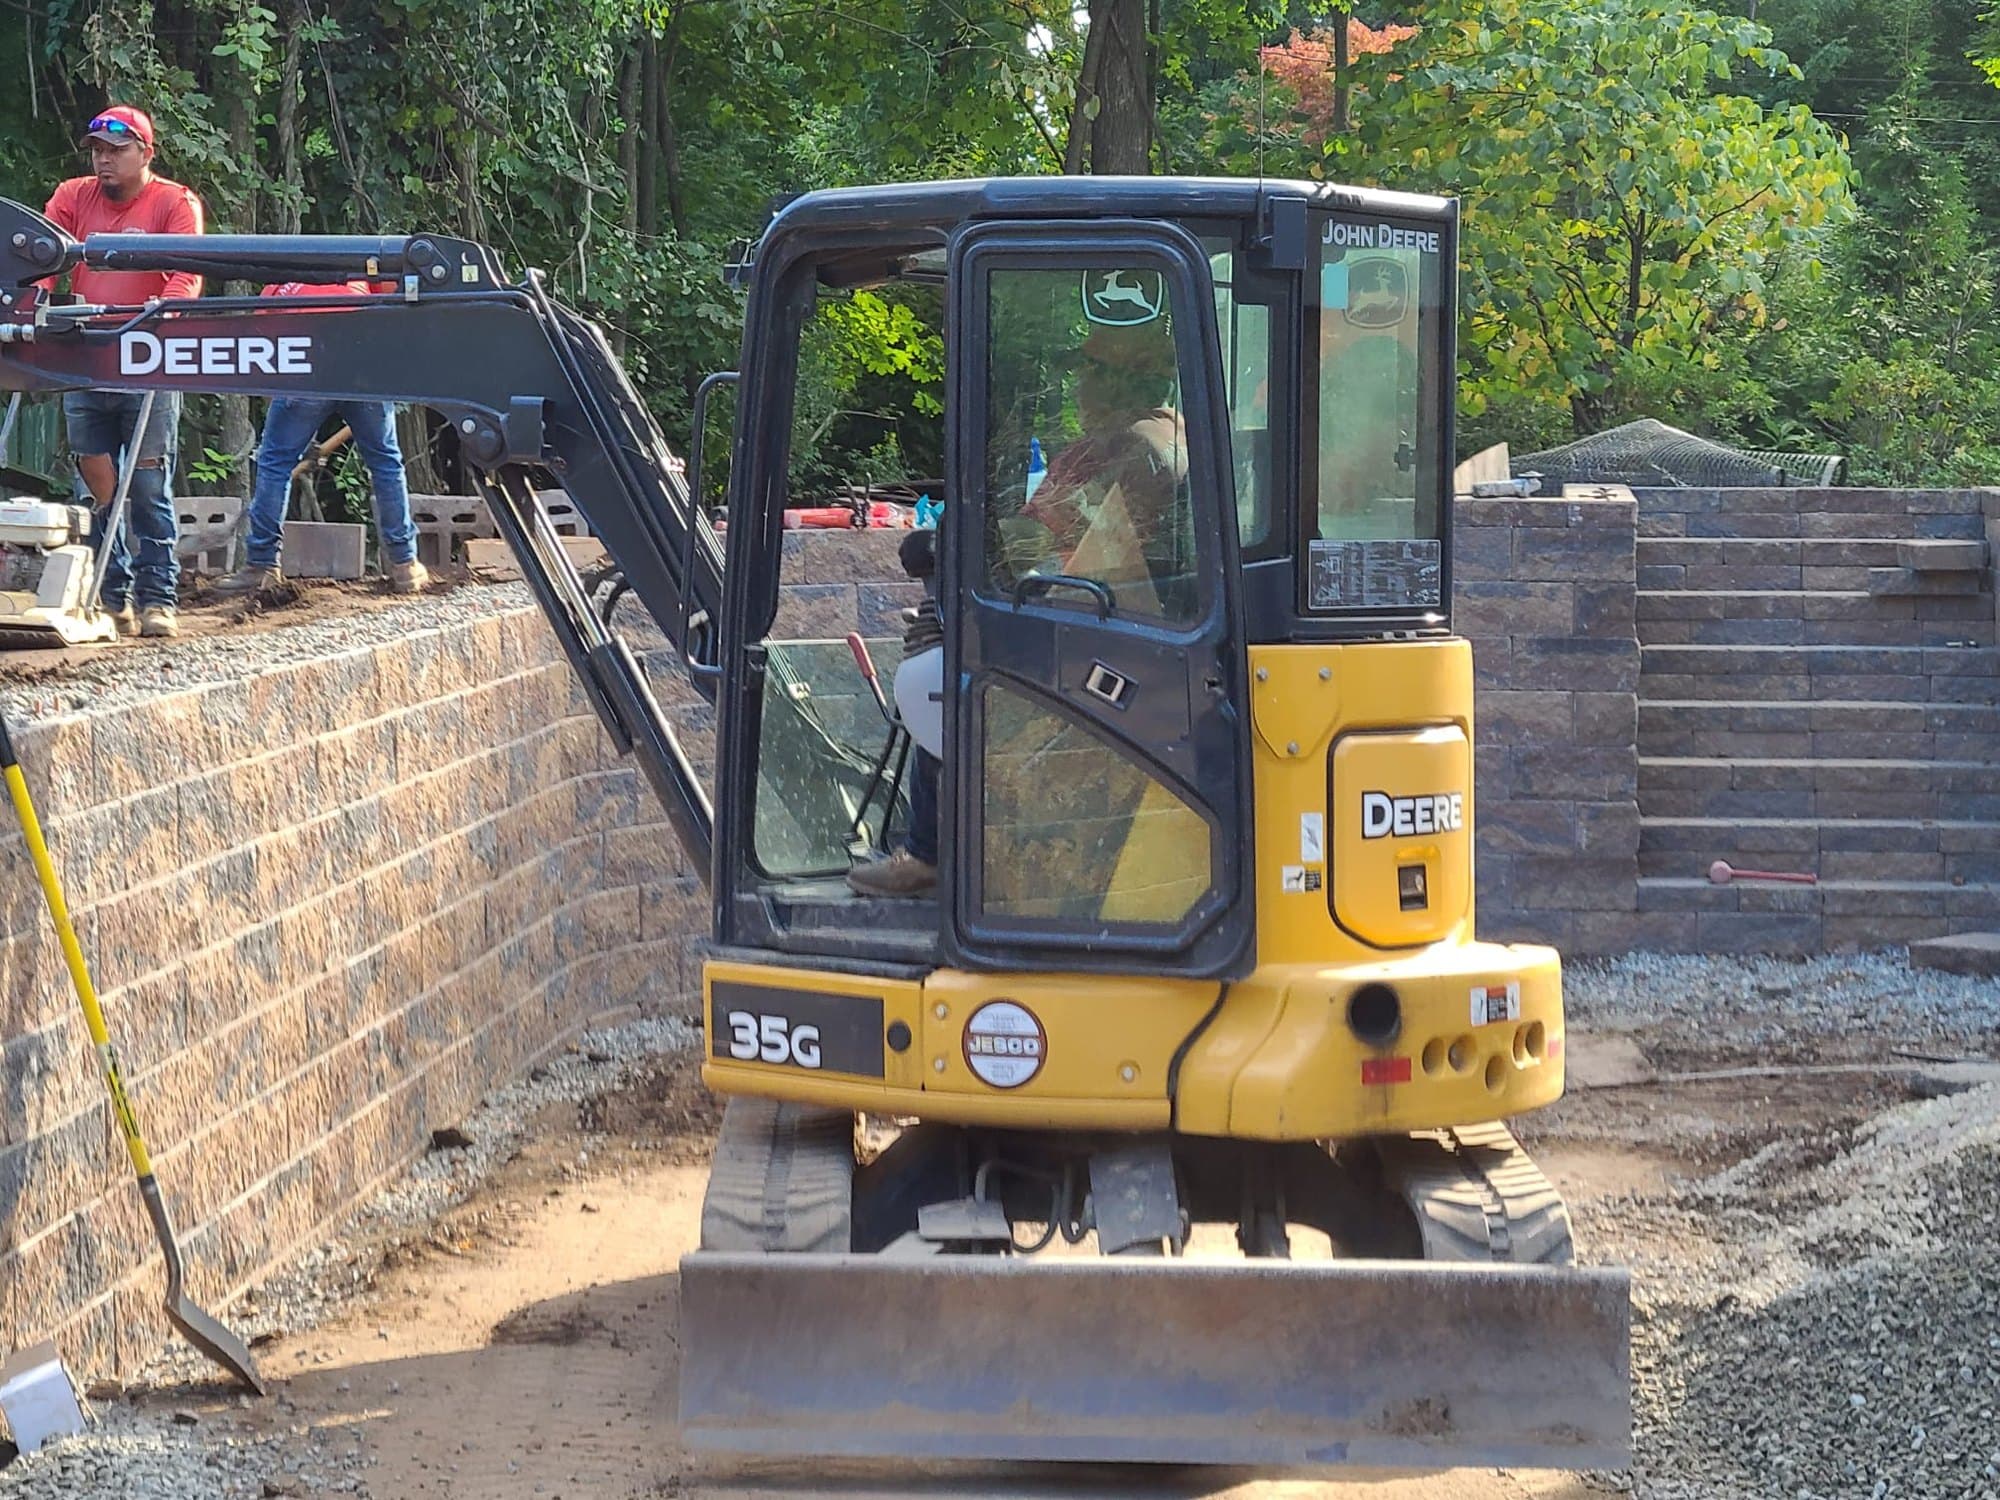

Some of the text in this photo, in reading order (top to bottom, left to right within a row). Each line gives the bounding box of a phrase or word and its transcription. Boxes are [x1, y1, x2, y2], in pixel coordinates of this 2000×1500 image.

[1322, 218, 1440, 253] JOHN DEERE
[120, 331, 312, 375] DEERE
[1361, 790, 1463, 839] DEERE
[728, 1010, 822, 1068] 35G
